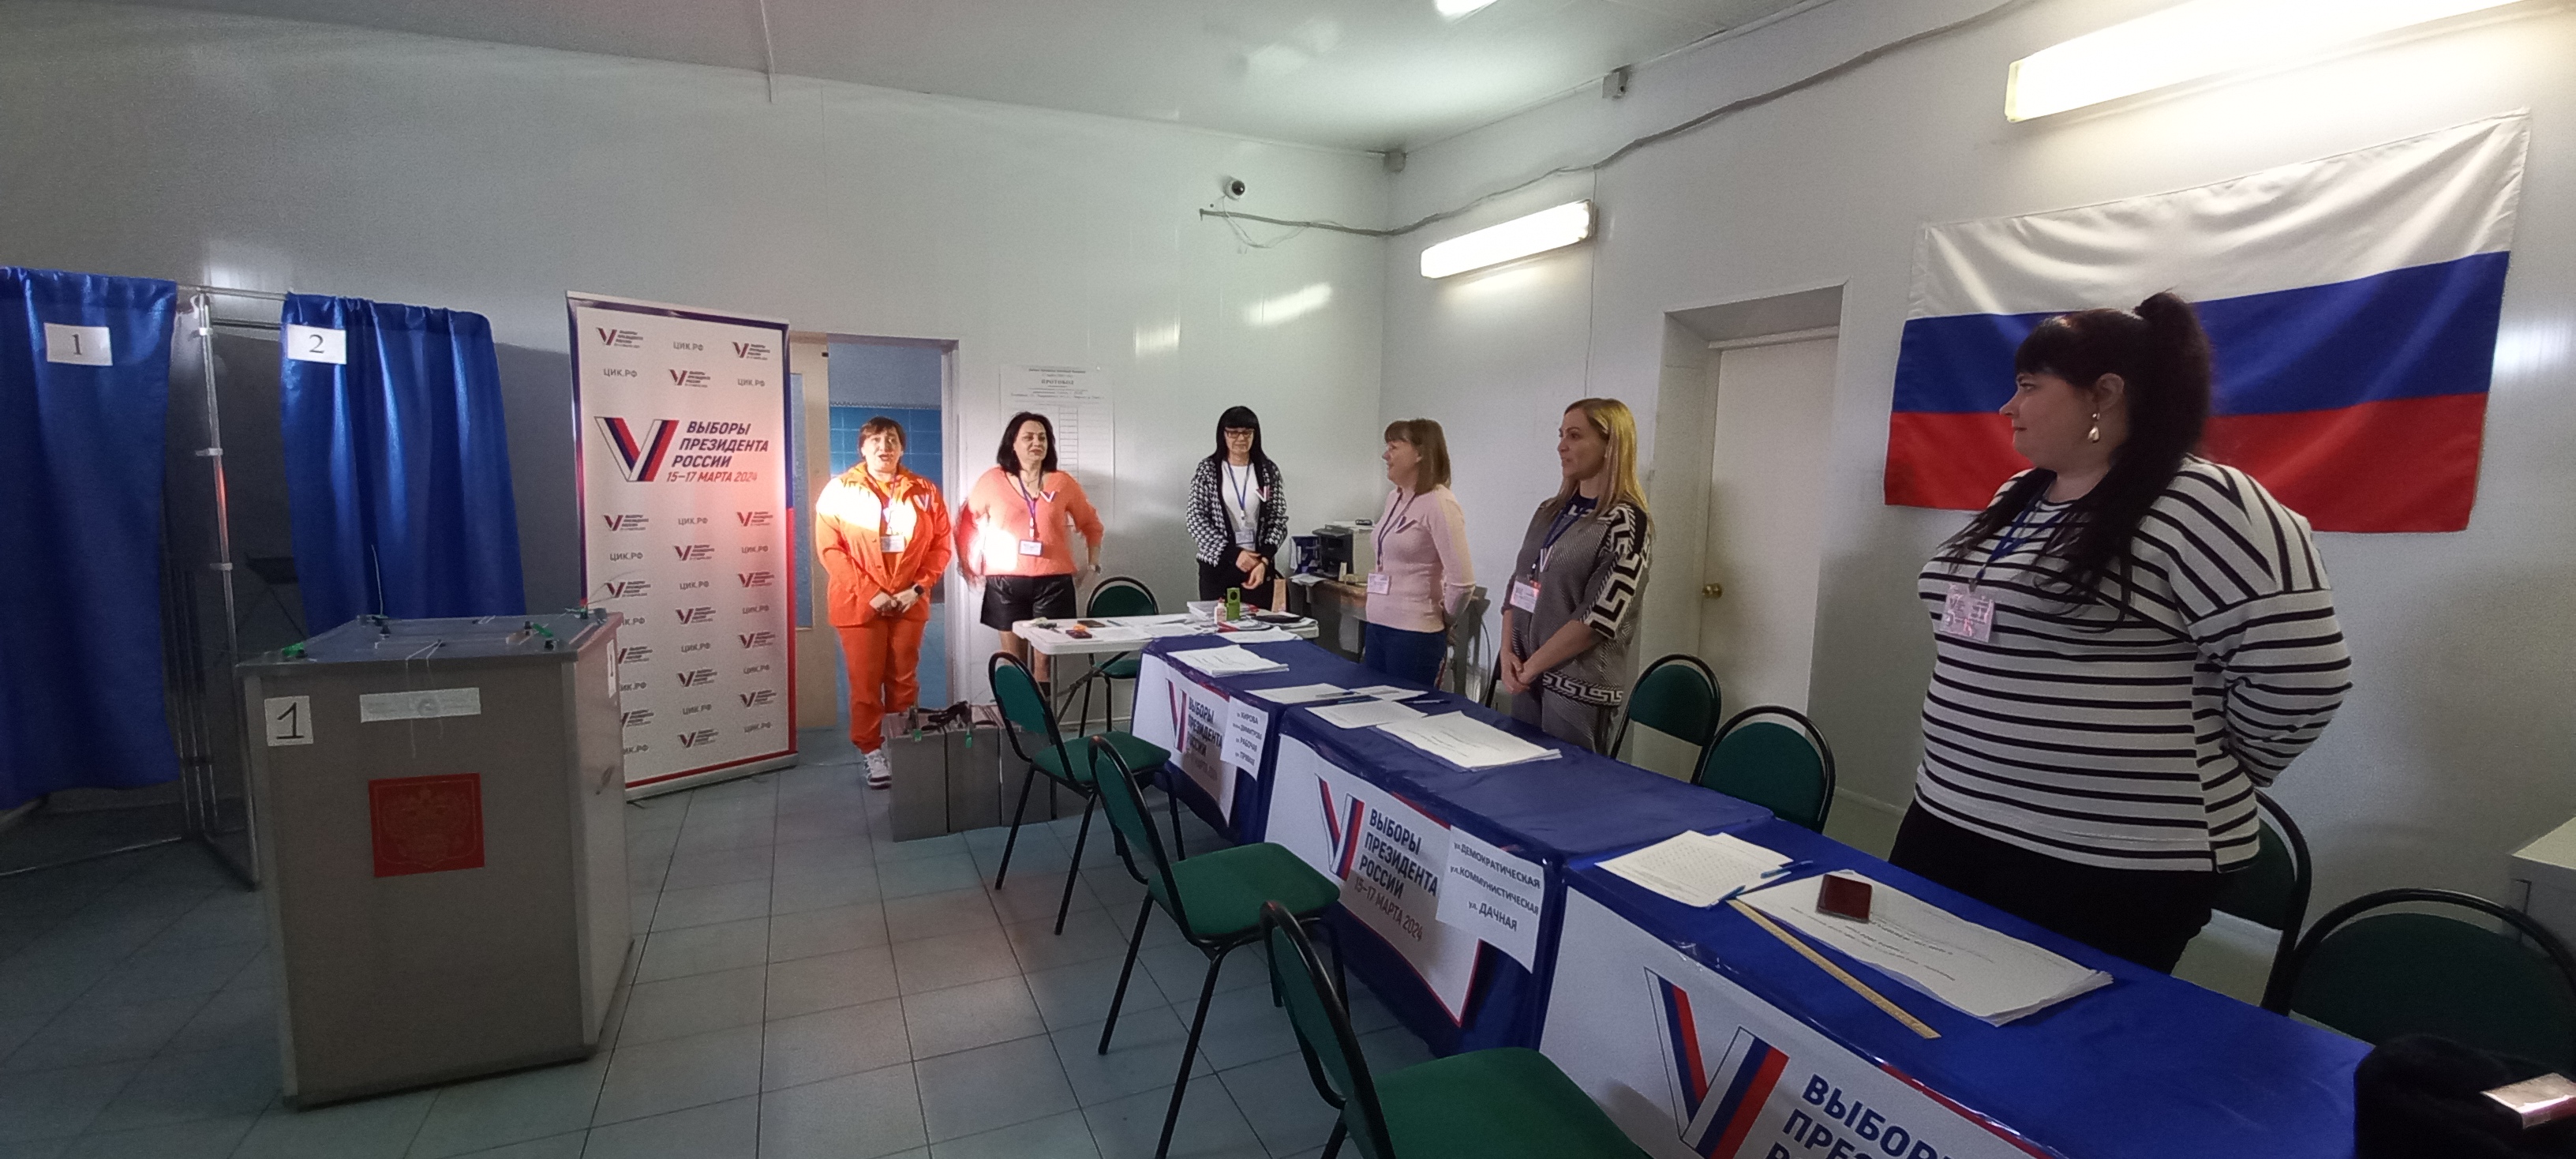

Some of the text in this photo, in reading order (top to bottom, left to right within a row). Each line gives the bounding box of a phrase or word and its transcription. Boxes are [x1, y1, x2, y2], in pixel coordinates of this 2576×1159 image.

[73, 333, 82, 355] 1
[309, 334, 325, 354] 2
[673, 341, 704, 351] ЦИК.РФ
[603, 368, 638, 377] ЦИК.РФ
[687, 421, 751, 435] ВЫБОРЫ
[679, 437, 769, 453] ПРЕЗИДЕНТА
[671, 455, 732, 467] РОССИИ
[697, 471, 732, 482] МАРТА
[733, 471, 758, 482] 2024
[678, 517, 709, 526] ЦИК.РФ
[609, 552, 643, 561] ЦИК.РФ
[622, 617, 646, 626] К.РФ
[1189, 696, 1215, 724] ВЫБОРЫ
[277, 702, 304, 739] 1
[1369, 808, 1421, 855] ВЫБОРЫ
[1364, 831, 1439, 897] ПРЕЗИДЕНТА
[1358, 854, 1405, 899] РОССИИ
[1376, 894, 1402, 927] МАРТА
[1402, 915, 1424, 941] 2024
[1478, 902, 1518, 932] ДАЧНАЯ
[1802, 1074, 1949, 1159] ВЫБОР
